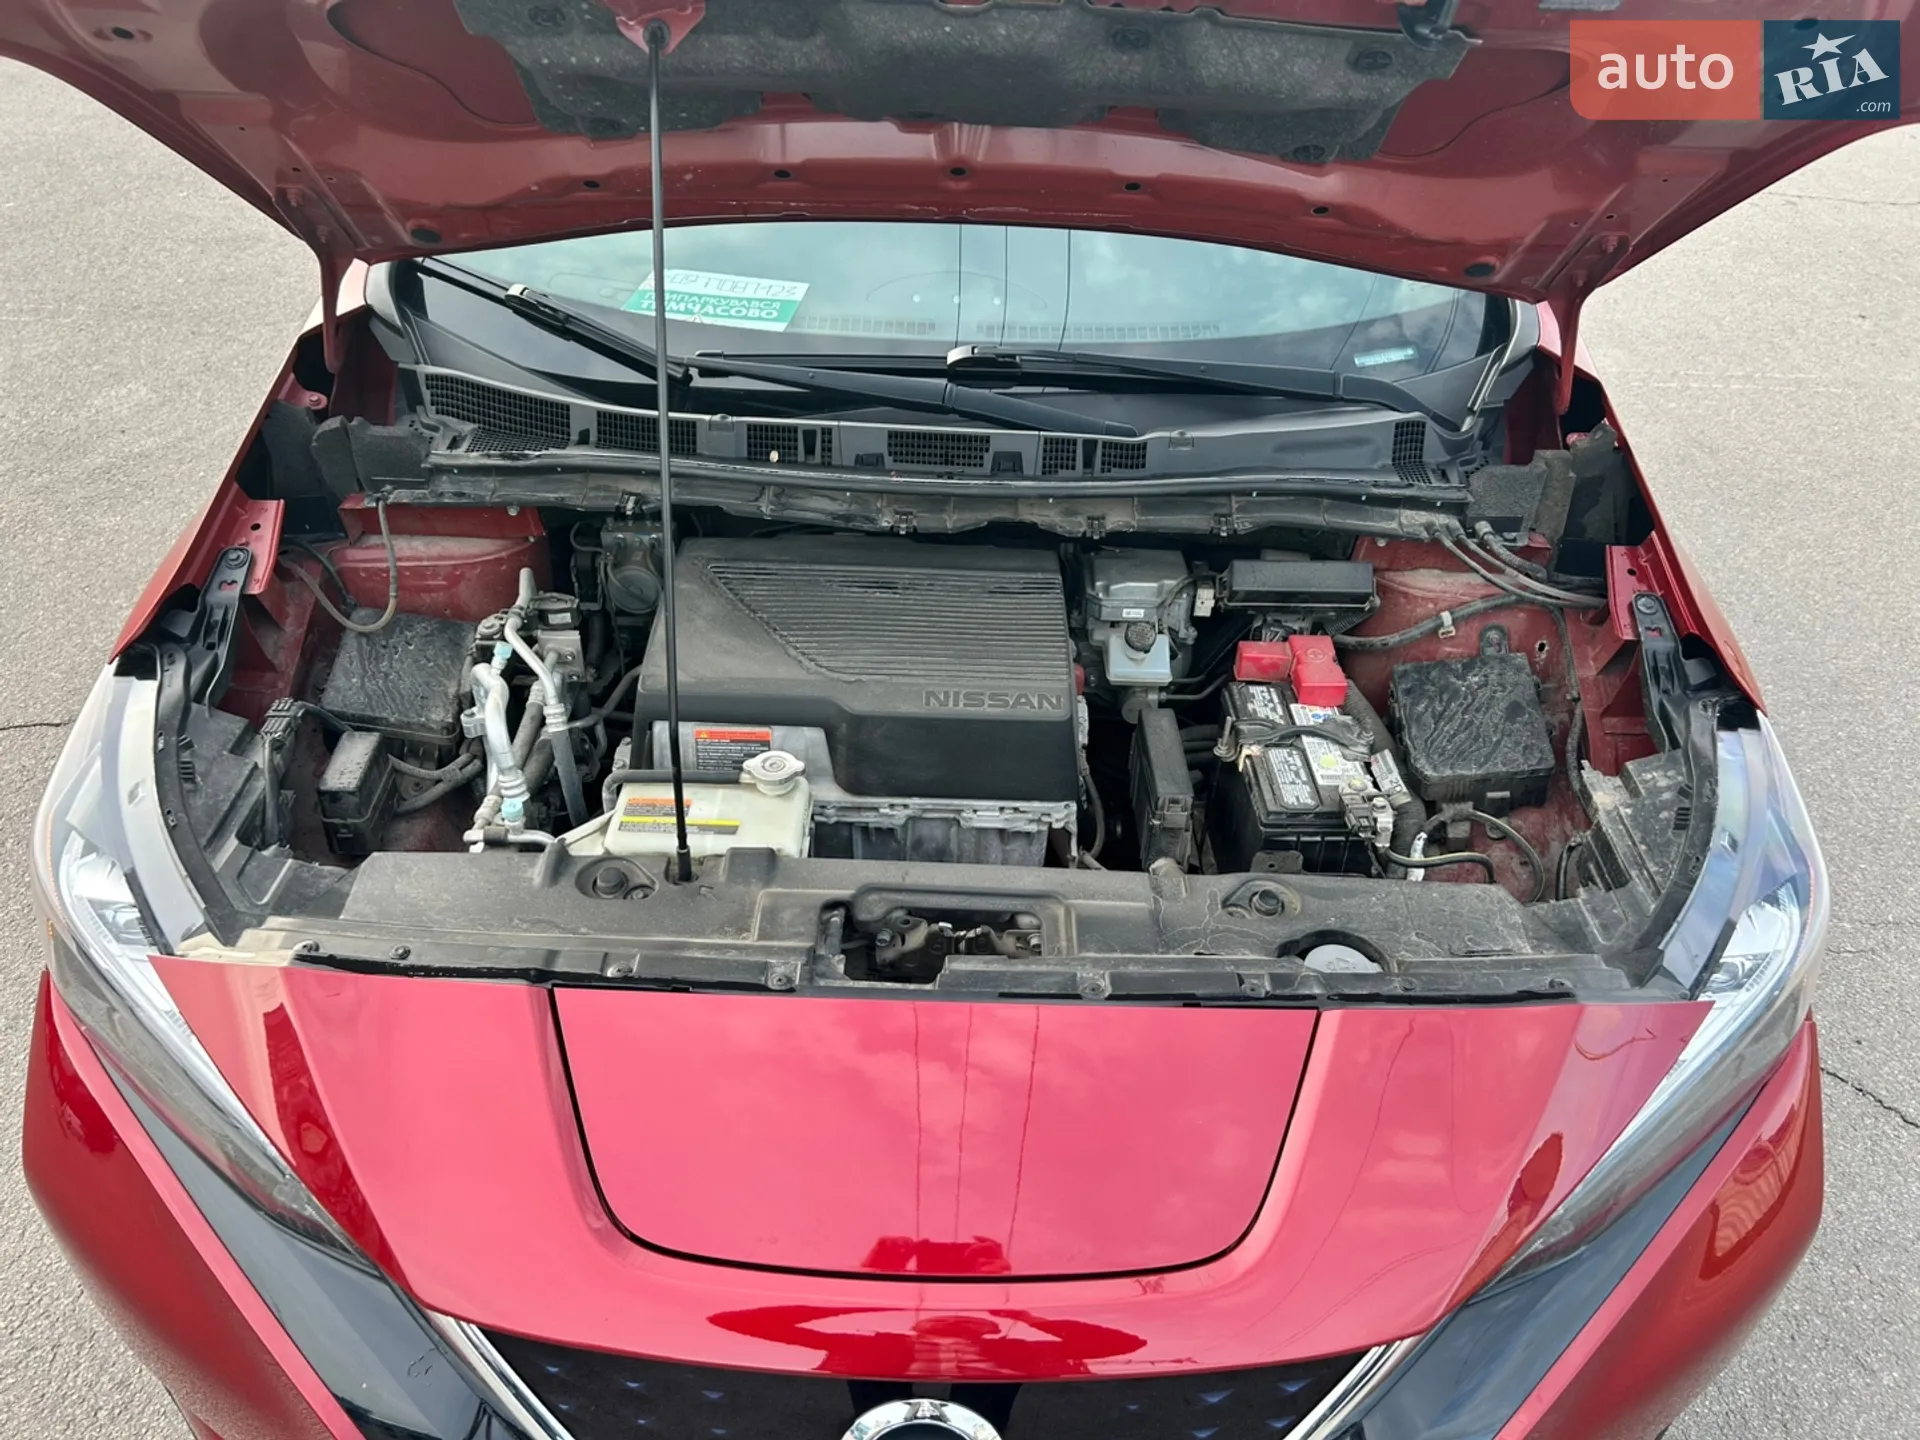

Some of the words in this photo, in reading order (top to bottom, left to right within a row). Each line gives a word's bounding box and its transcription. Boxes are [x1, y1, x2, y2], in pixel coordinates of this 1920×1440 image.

[640, 299, 779, 319] ТМЧАСОВО
[643, 291, 780, 310] ПИПАРКУВАВСЯ
[923, 689, 1063, 711] NISSAN
